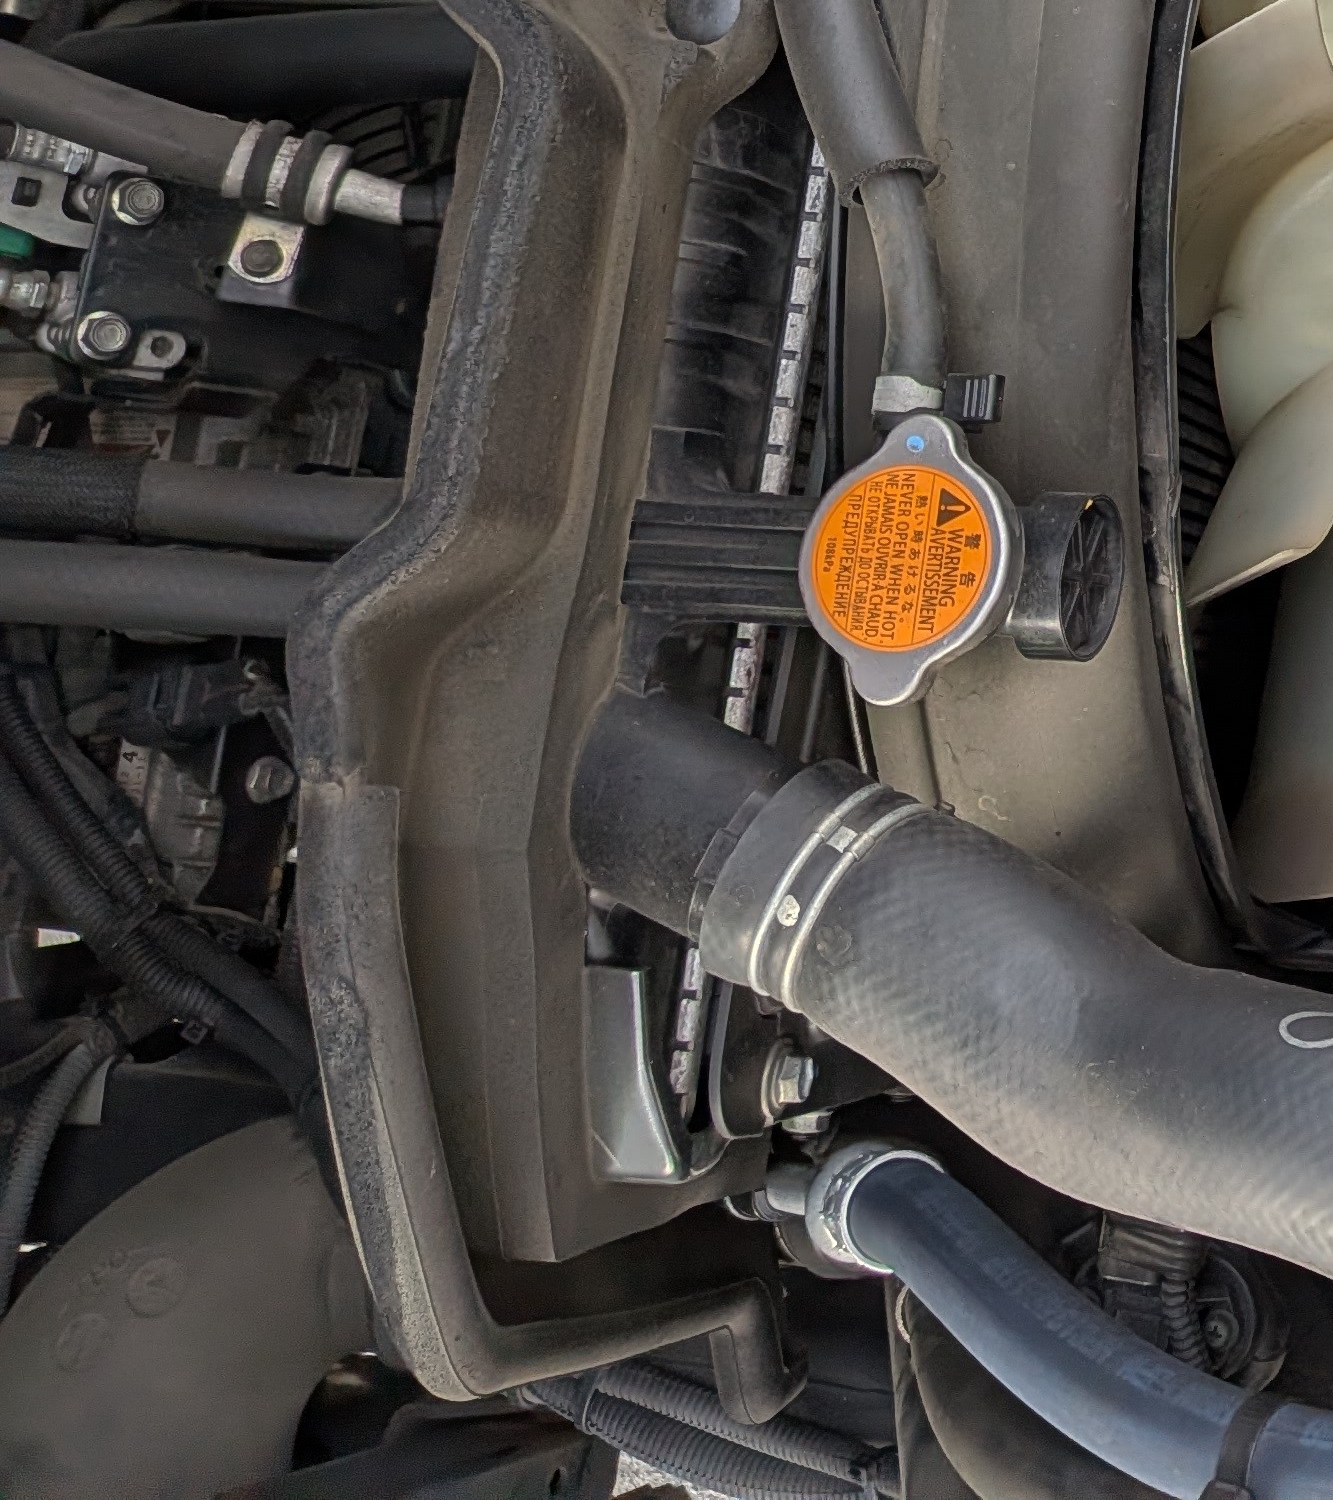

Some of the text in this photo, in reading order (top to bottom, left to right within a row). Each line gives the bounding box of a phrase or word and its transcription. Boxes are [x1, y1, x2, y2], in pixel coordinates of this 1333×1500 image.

[869, 481, 882, 495] НЕ
[885, 473, 900, 489] NE
[899, 473, 916, 517] NEVER
[878, 490, 898, 537] JAMAIS
[833, 494, 862, 618] ПРЕДУПРЕЖДЕНИЕ
[892, 521, 909, 560] OPEN
[886, 563, 902, 606] WHEN
[918, 528, 945, 634] AVERTISSEMENT
[939, 527, 965, 608] WARNING
